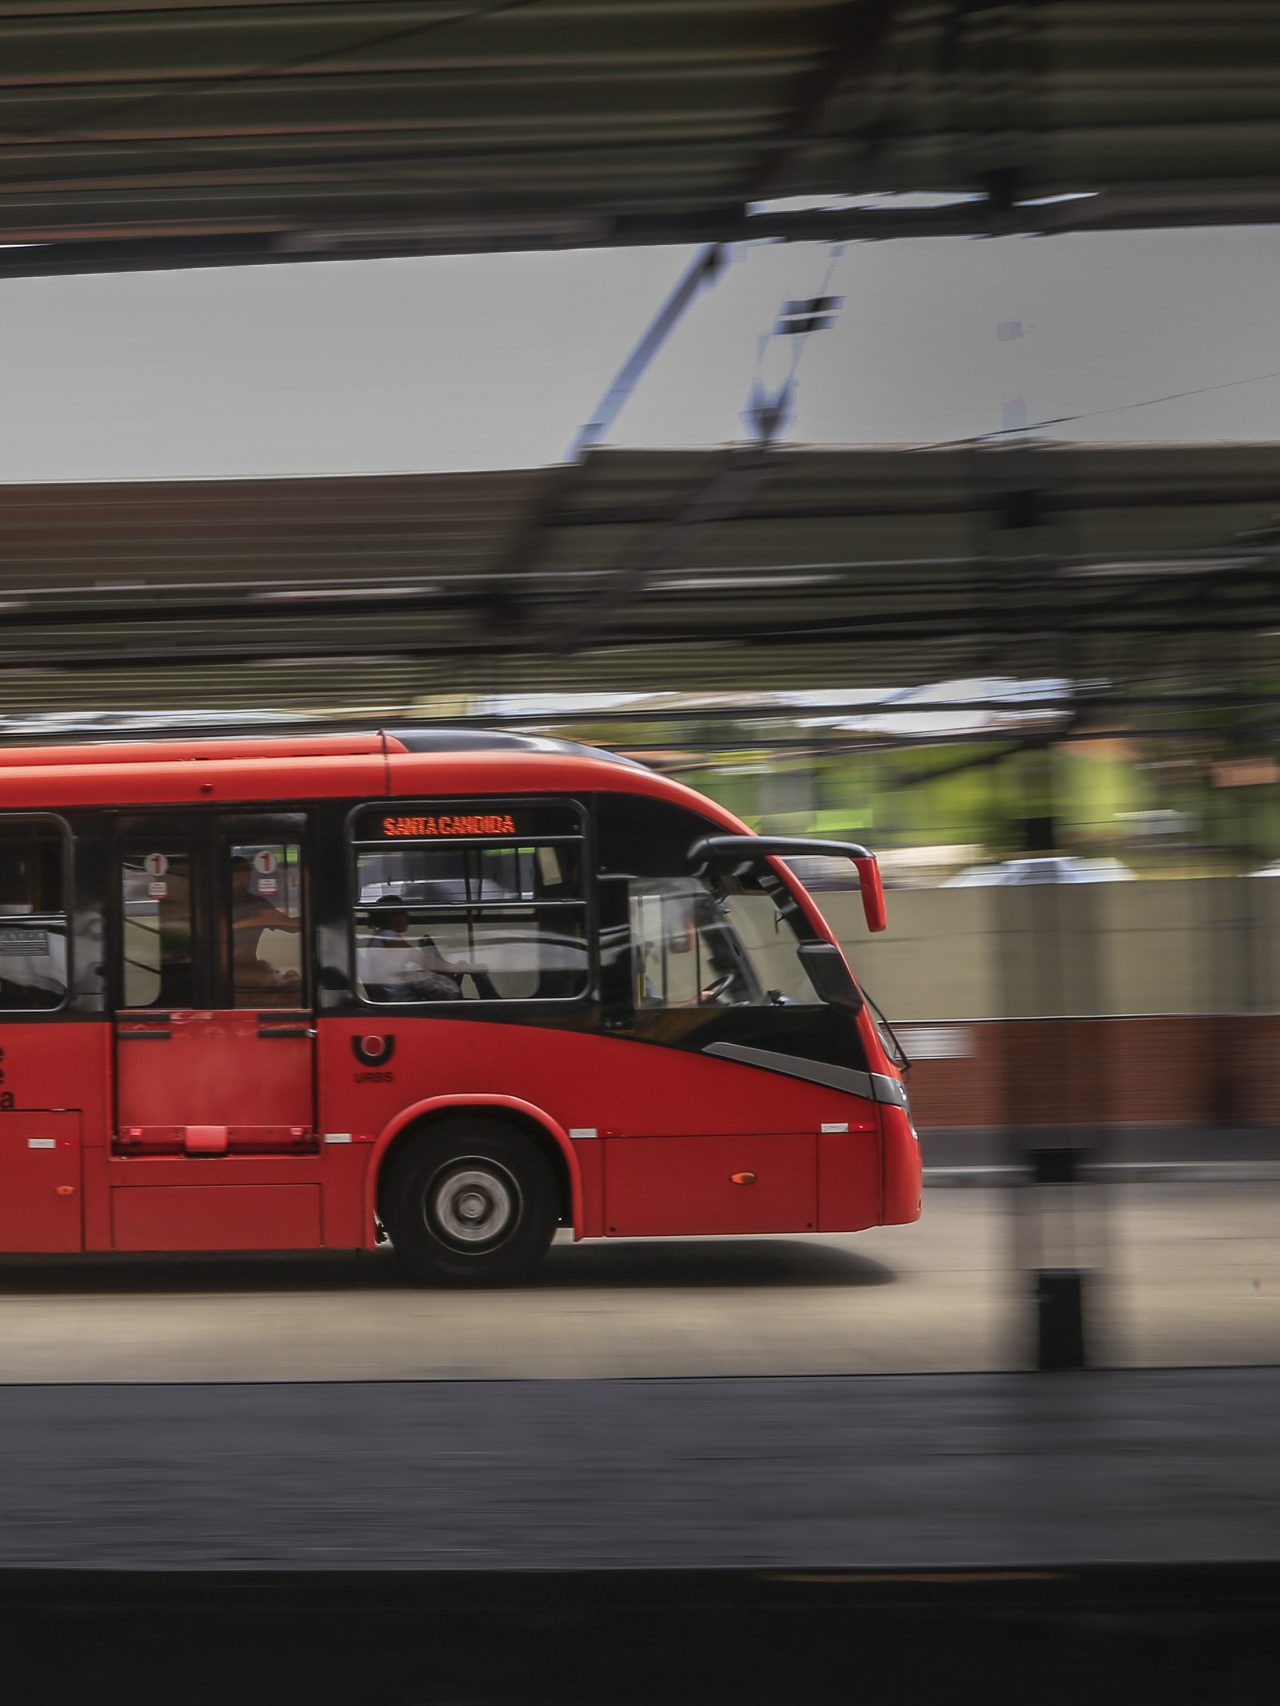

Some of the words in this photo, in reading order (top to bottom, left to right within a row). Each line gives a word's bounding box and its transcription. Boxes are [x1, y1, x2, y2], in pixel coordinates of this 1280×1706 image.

[383, 817, 438, 835] SANTA
[150, 854, 162, 875] 1
[259, 852, 271, 872] 1
